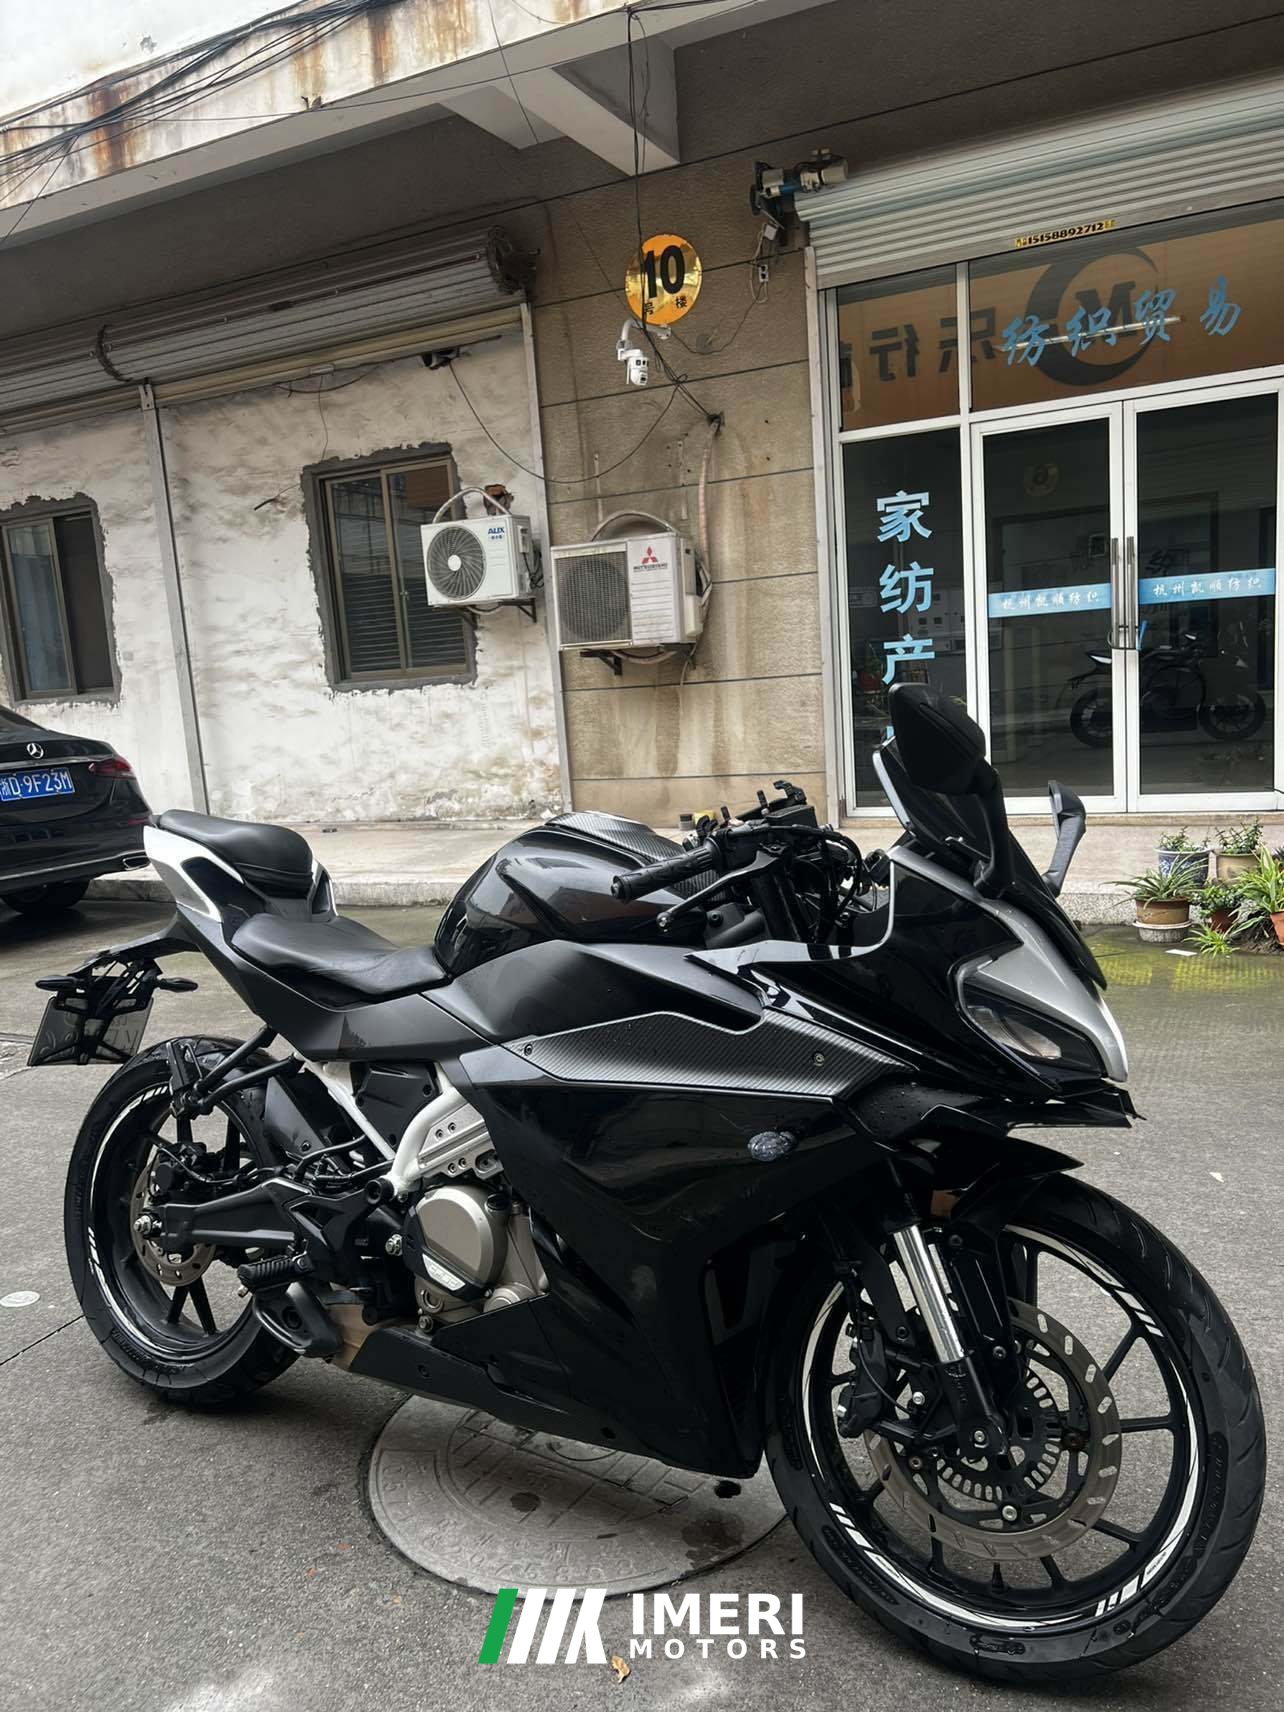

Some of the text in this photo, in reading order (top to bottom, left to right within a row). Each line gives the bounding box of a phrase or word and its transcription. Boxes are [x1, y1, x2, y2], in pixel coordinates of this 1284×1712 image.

[644, 245, 685, 299] 10
[1000, 273, 1242, 367] 纺织贸易
[877, 489, 936, 738] 家纺产
